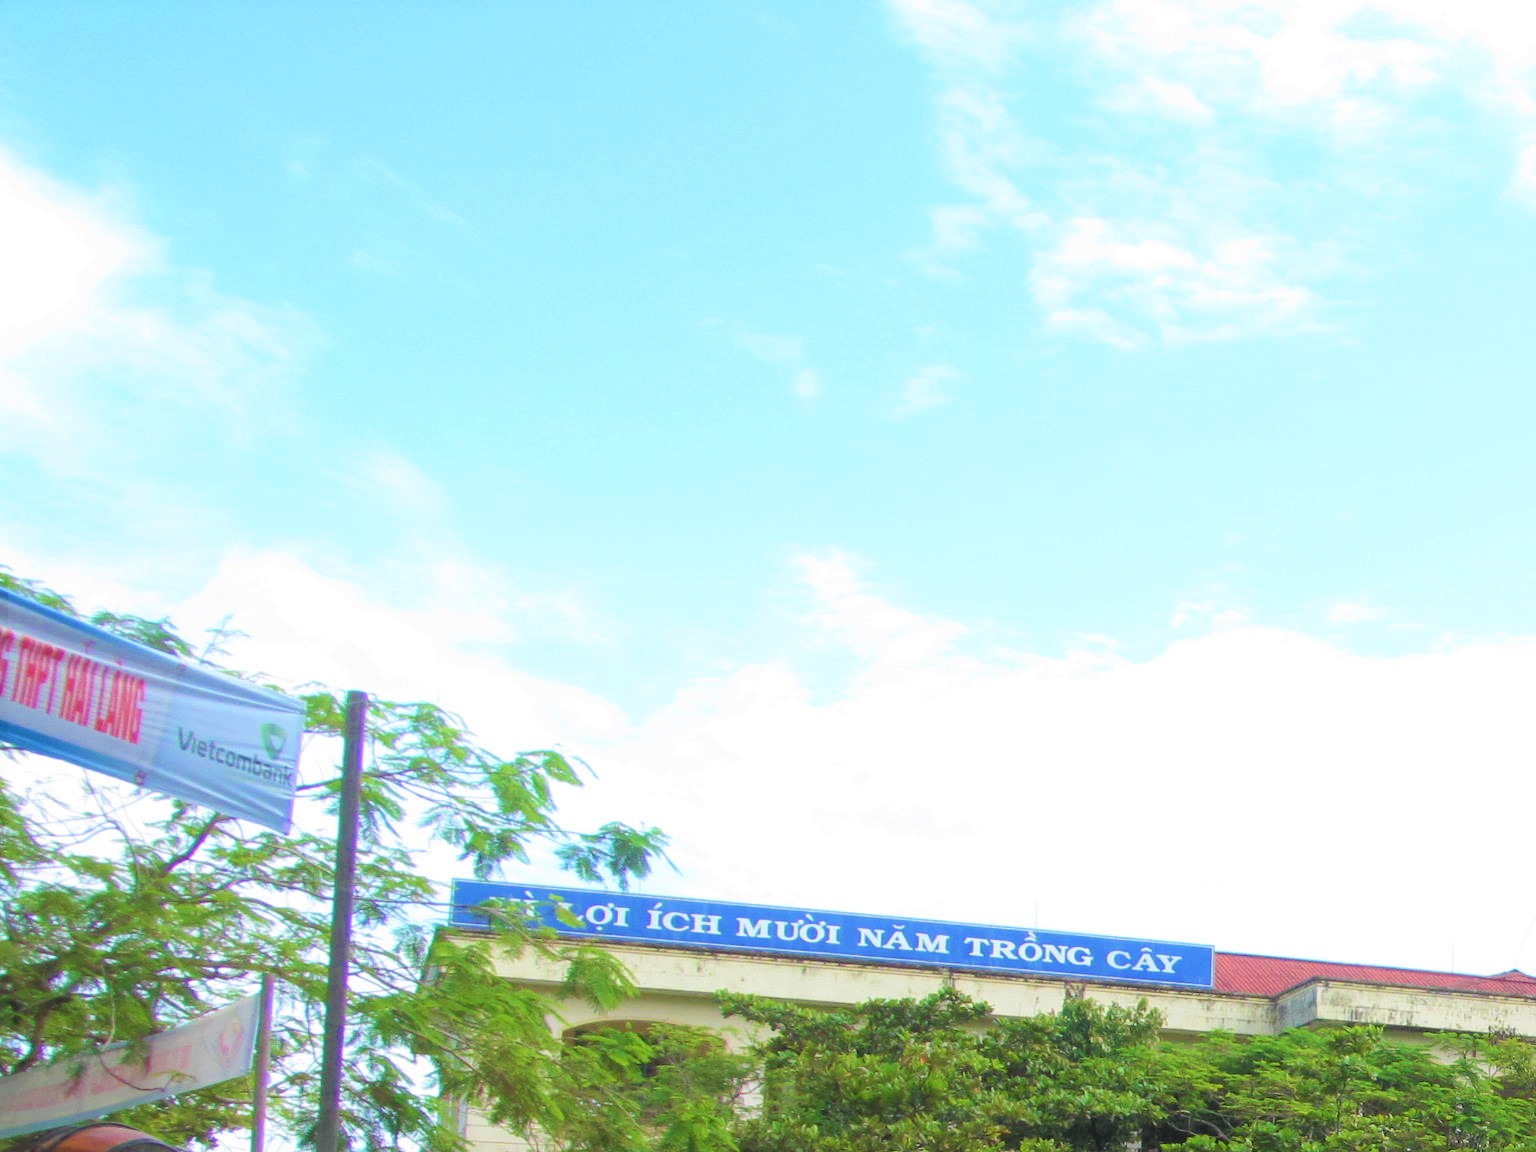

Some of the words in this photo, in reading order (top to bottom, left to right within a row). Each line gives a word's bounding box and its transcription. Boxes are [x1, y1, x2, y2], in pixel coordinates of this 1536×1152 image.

[9, 634, 66, 716] THPT
[177, 726, 297, 789] Vietcombank
[647, 902, 722, 936] ÍCH
[735, 913, 841, 946] MƯỜI
[856, 924, 950, 955] NĂM
[963, 930, 1094, 967] TRỒNG
[1106, 946, 1183, 975] CÂY
